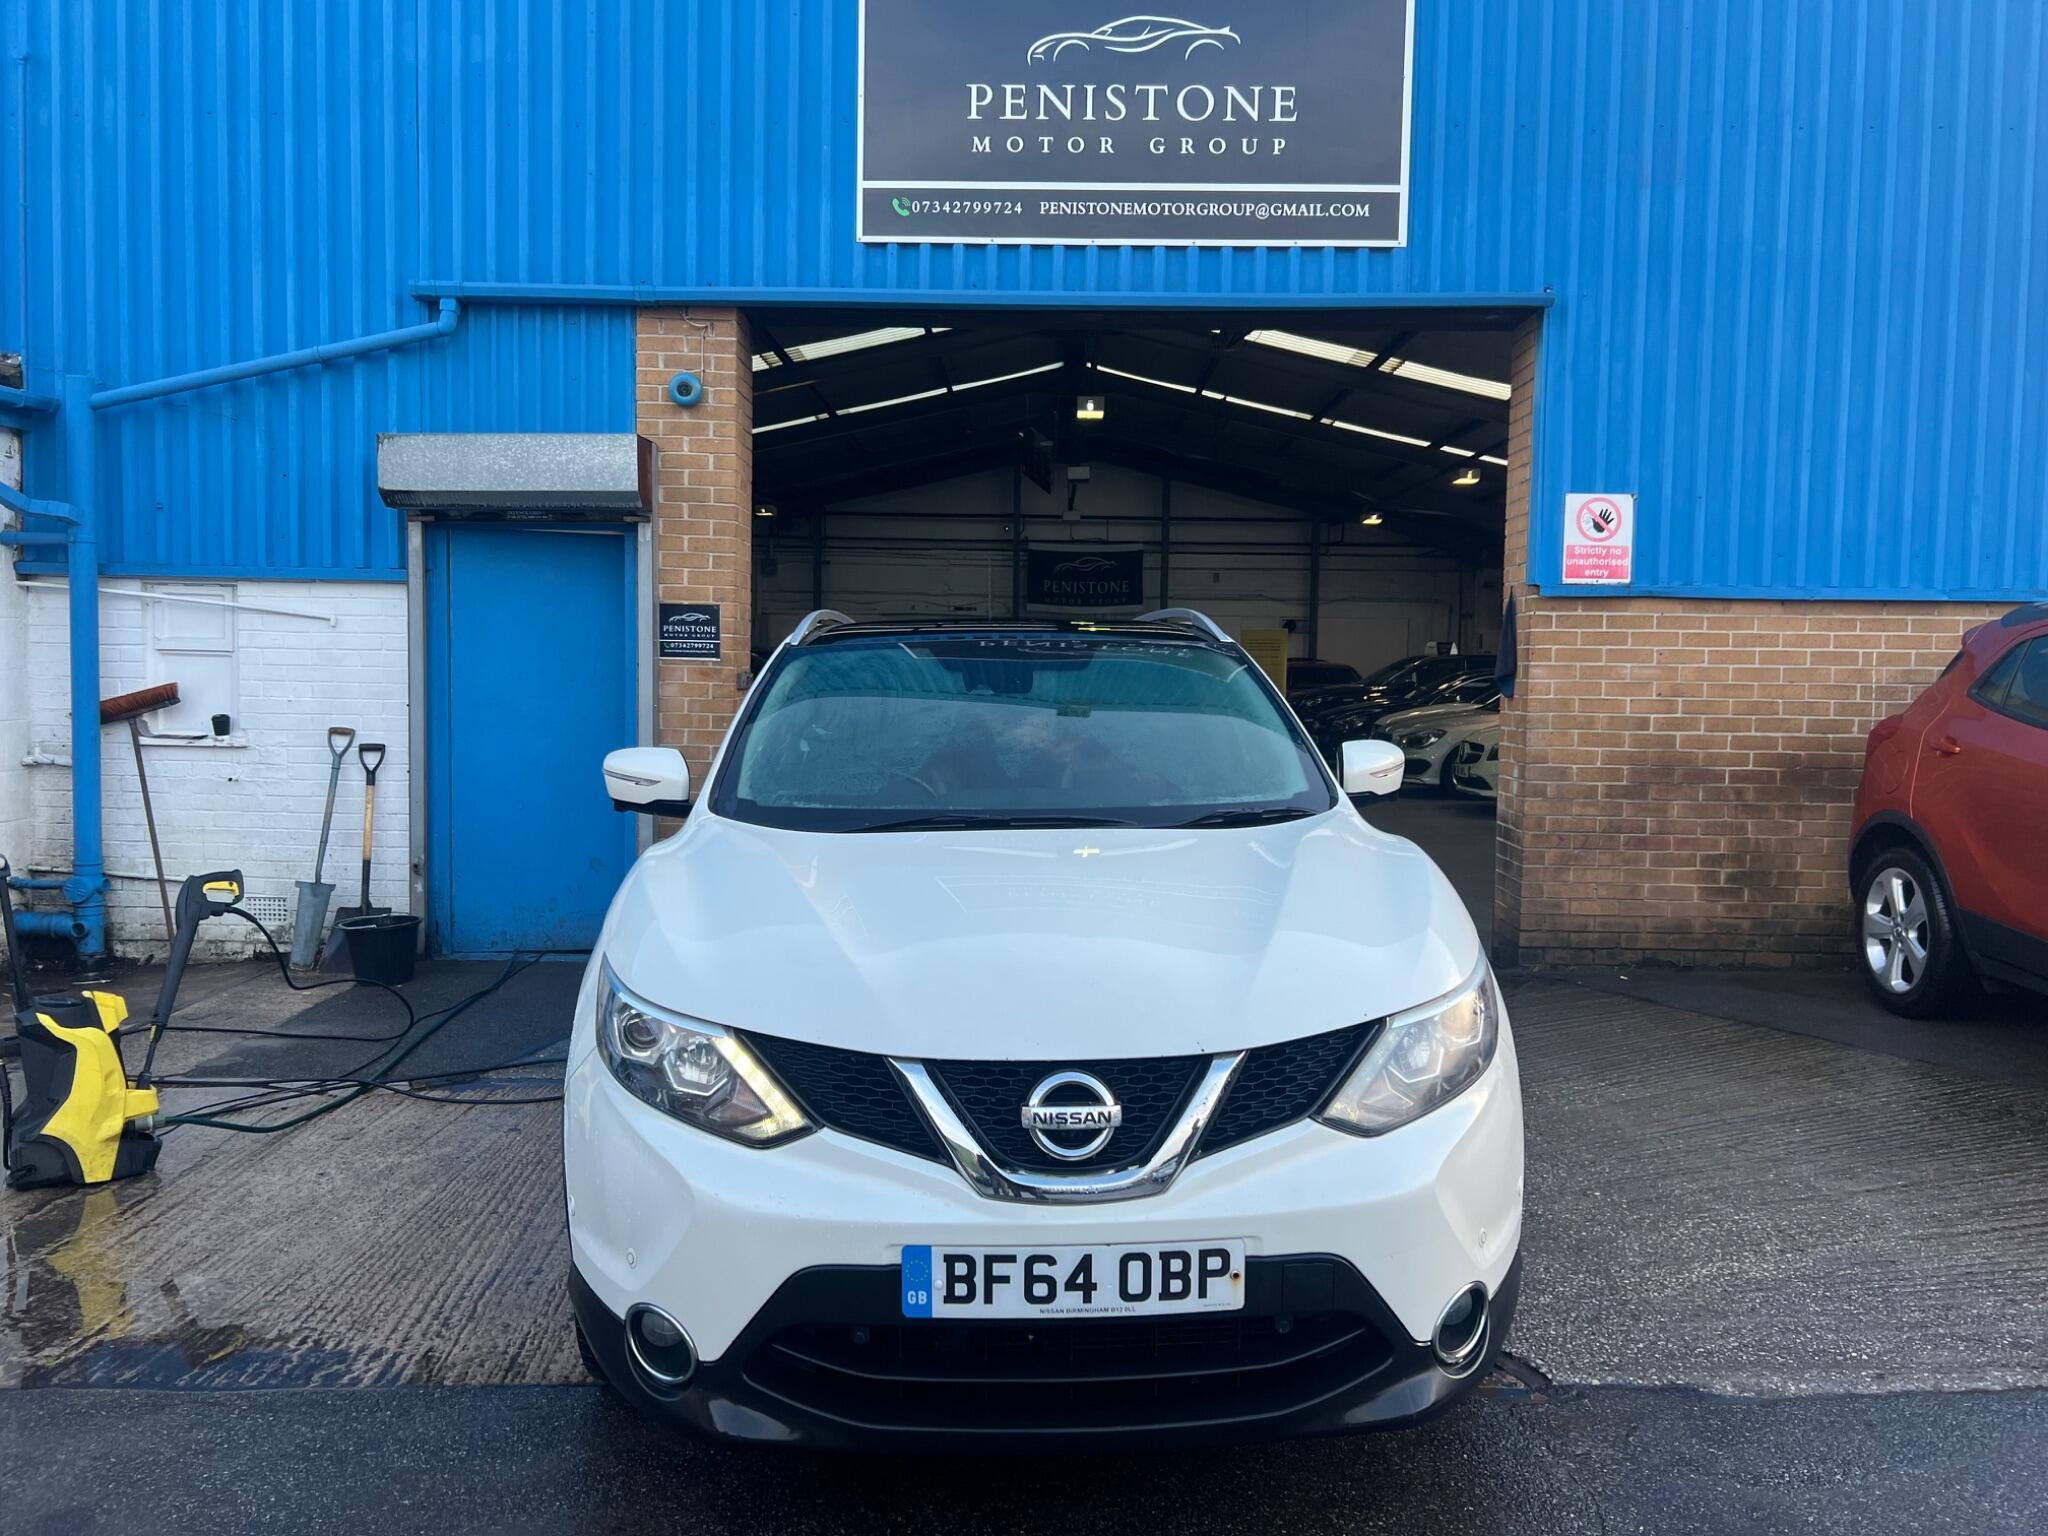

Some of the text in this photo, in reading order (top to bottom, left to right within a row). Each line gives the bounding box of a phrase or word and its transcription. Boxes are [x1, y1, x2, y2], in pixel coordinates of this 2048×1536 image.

[966, 83, 1298, 122] PENISTONE
[971, 135, 1287, 155] MOTOR GROUP
[911, 200, 1370, 219] 07342799724 PENISTONEMOTORGROUP@GMAIL.COM
[1574, 546, 1623, 557] Strictly no
[1566, 557, 1629, 567] unauthorised
[1584, 568, 1610, 579] entry
[1043, 579, 1130, 594] PENISTONE
[663, 625, 717, 633] PENISTONE
[1033, 1111, 1112, 1125] NISSAN
[943, 1248, 1231, 1305] BF64 OBP
[907, 1290, 927, 1304] GB
